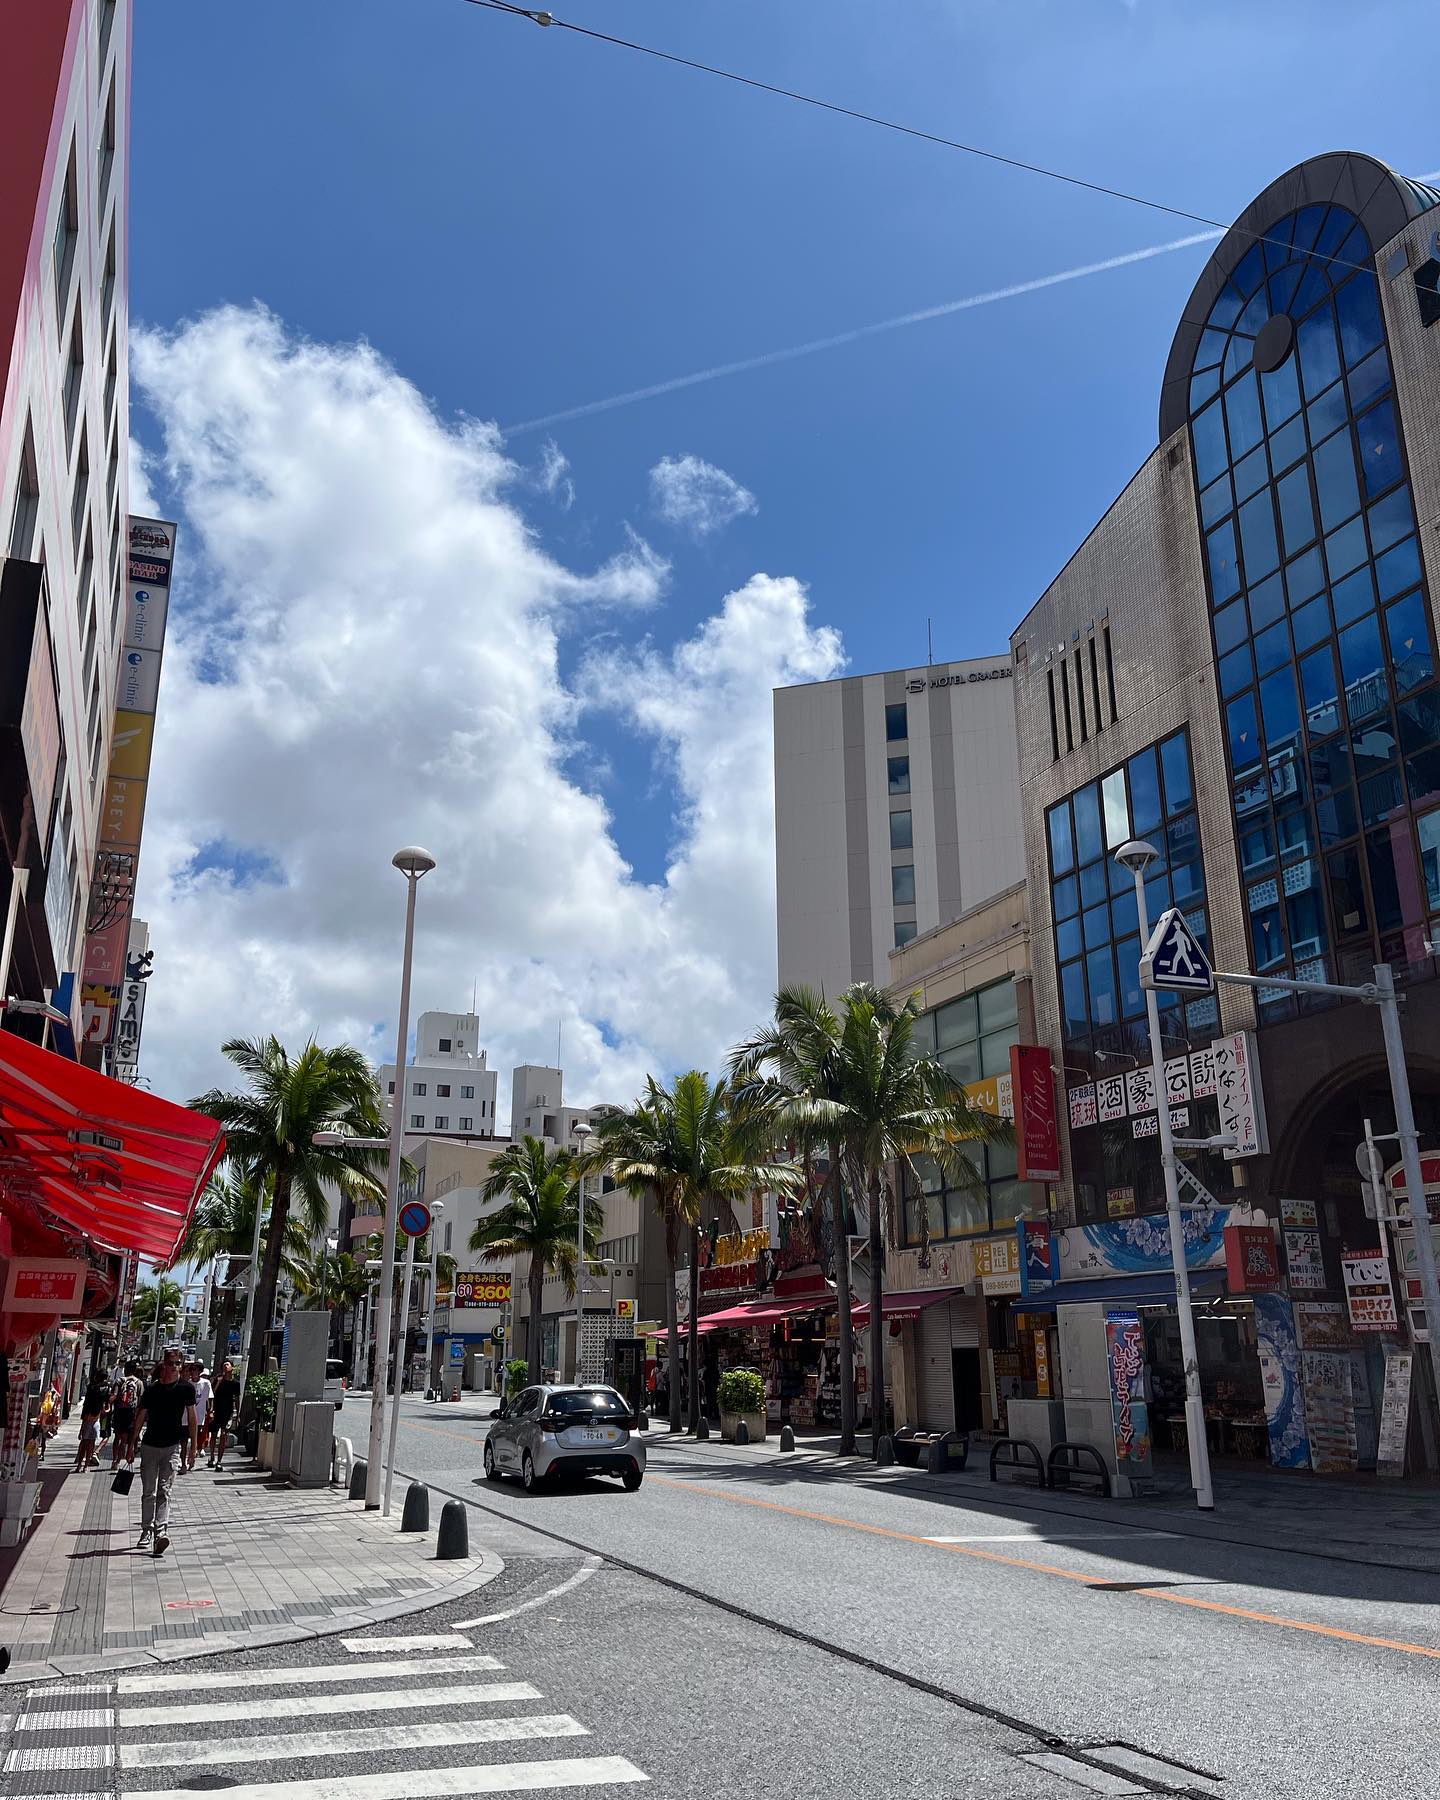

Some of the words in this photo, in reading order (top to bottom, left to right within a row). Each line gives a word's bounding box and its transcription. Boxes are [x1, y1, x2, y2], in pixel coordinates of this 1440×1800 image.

[134, 569, 159, 579] BAR
[133, 603, 147, 642] e-clinic
[126, 666, 139, 706] e-clinic
[930, 674, 966, 689] HOTEL
[1104, 1108, 1121, 1119] SHU
[1136, 1102, 1150, 1114] GO
[1243, 1115, 1253, 1140] 2F
[1303, 1233, 1317, 1246] 2F
[1344, 1262, 1384, 1281] でいご
[457, 1284, 473, 1298] 60
[618, 1301, 629, 1316] P
